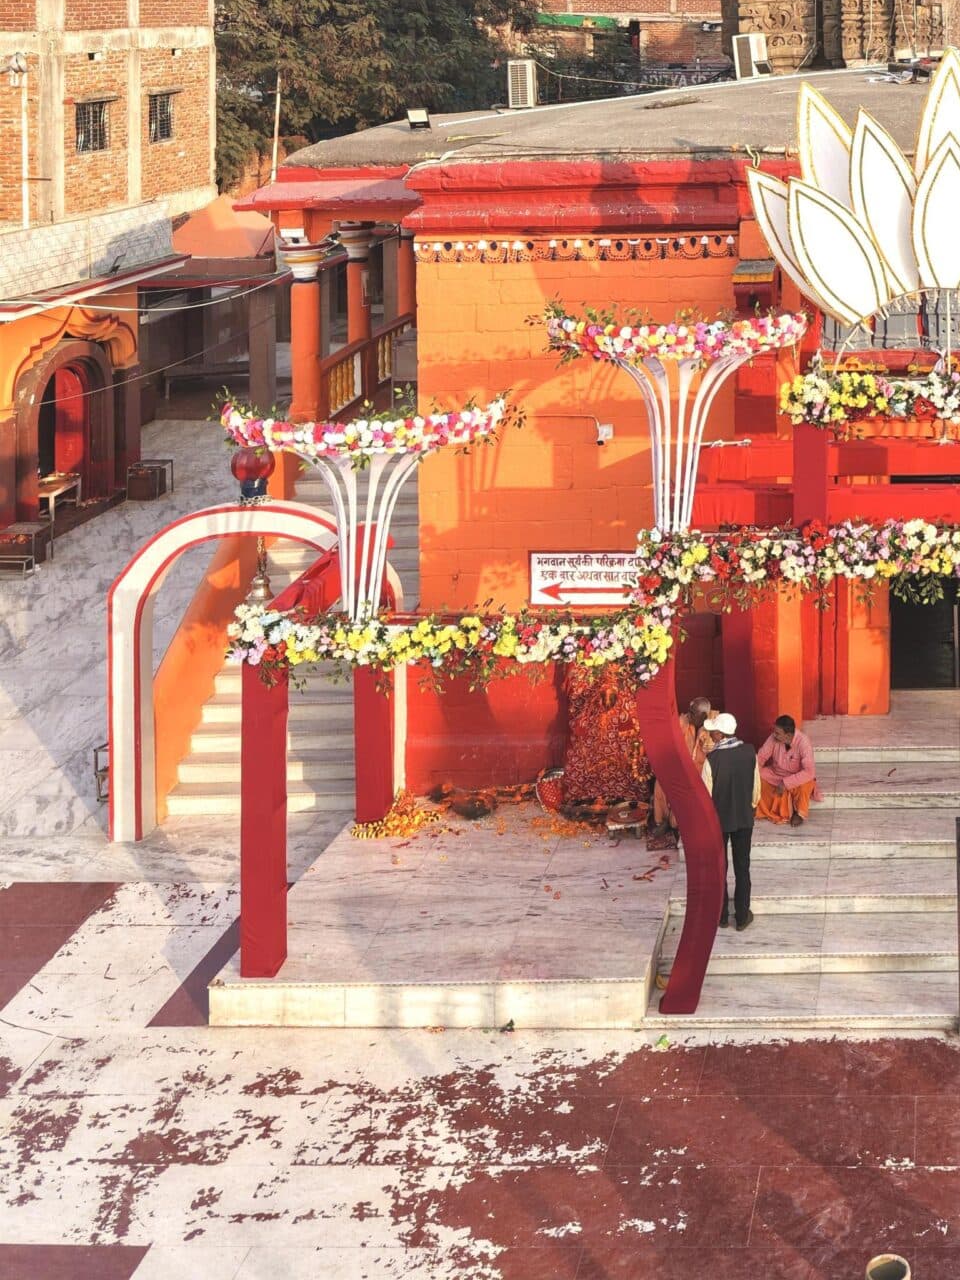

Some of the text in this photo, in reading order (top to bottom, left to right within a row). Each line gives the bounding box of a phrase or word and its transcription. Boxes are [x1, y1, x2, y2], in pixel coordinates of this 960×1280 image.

[536, 556, 566, 567] भगवान
[596, 554, 625, 568] परिक्रमा
[540, 570, 557, 581] एक
